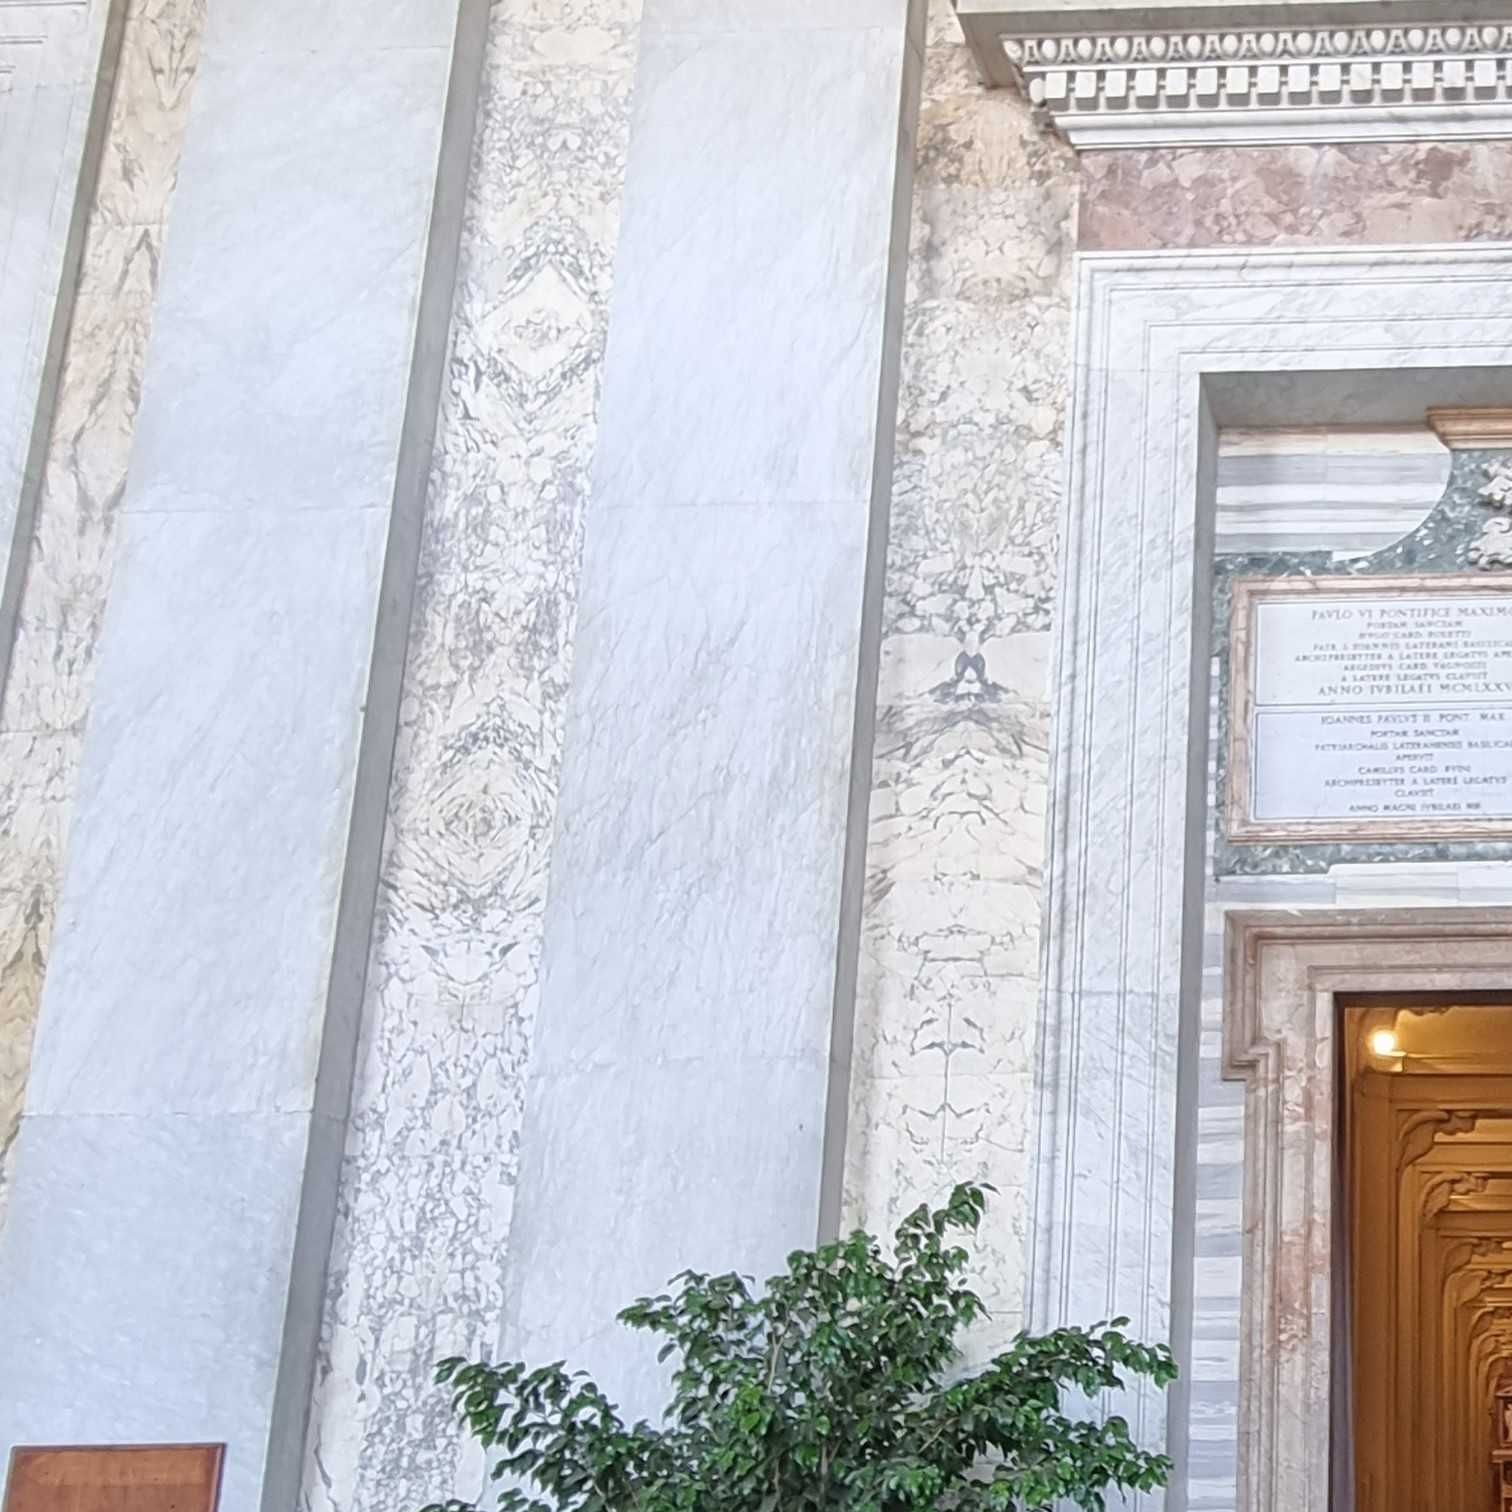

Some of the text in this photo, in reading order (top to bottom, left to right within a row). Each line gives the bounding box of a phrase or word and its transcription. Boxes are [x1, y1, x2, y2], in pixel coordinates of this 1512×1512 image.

[1312, 609, 1352, 621] PAVLO
[1358, 609, 1372, 619] VI
[1380, 608, 1450, 619] PONTIFICE
[1318, 685, 1363, 696] ANNO
[1321, 715, 1372, 725] IOANNES
